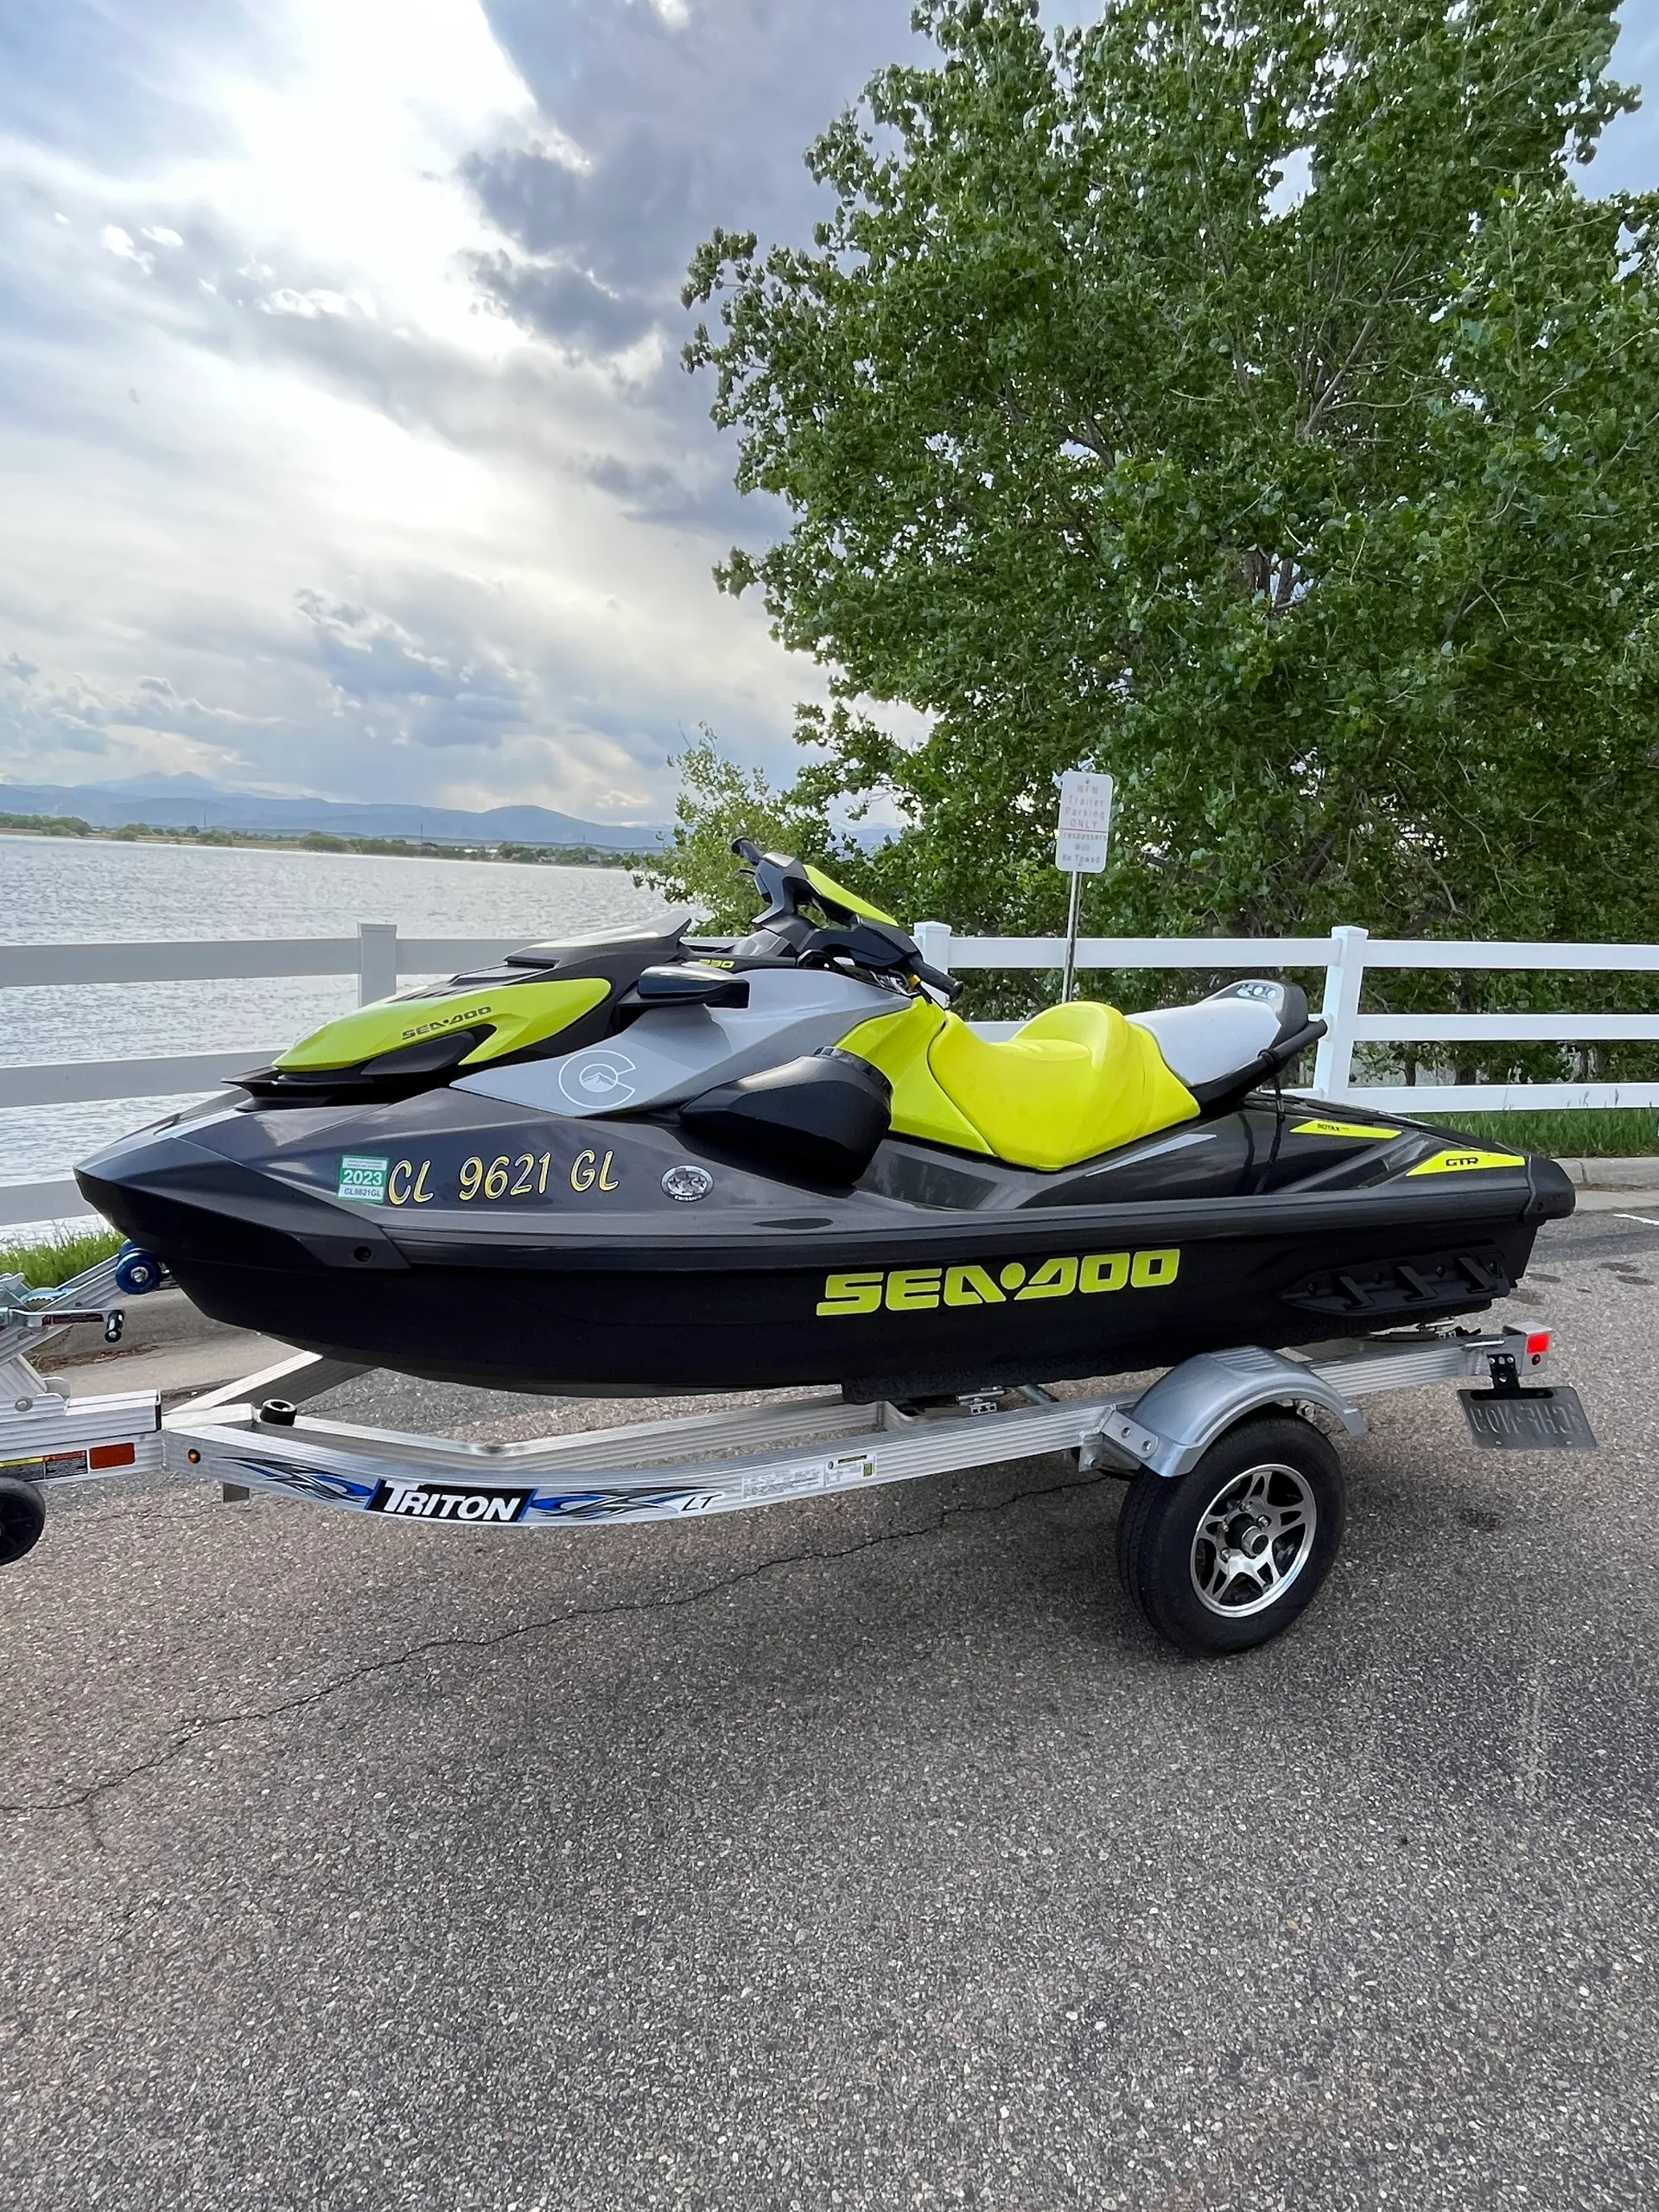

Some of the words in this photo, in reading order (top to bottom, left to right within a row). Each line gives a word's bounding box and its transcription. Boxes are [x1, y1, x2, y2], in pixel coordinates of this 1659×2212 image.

[1069, 795, 1104, 806] Trailer
[1065, 807, 1105, 820] Parking
[1070, 818, 1098, 829] ONLY
[1075, 855, 1100, 864] Towed
[1317, 1123, 1341, 1132] ROTAX
[1446, 1157, 1479, 1167] GTR
[342, 1169, 383, 1186] 2023
[387, 1159, 435, 1205] CL
[459, 1151, 552, 1202] 9621
[569, 1148, 620, 1192] GL
[382, 1480, 522, 1522] TRITON
[681, 1494, 722, 1511] LT
